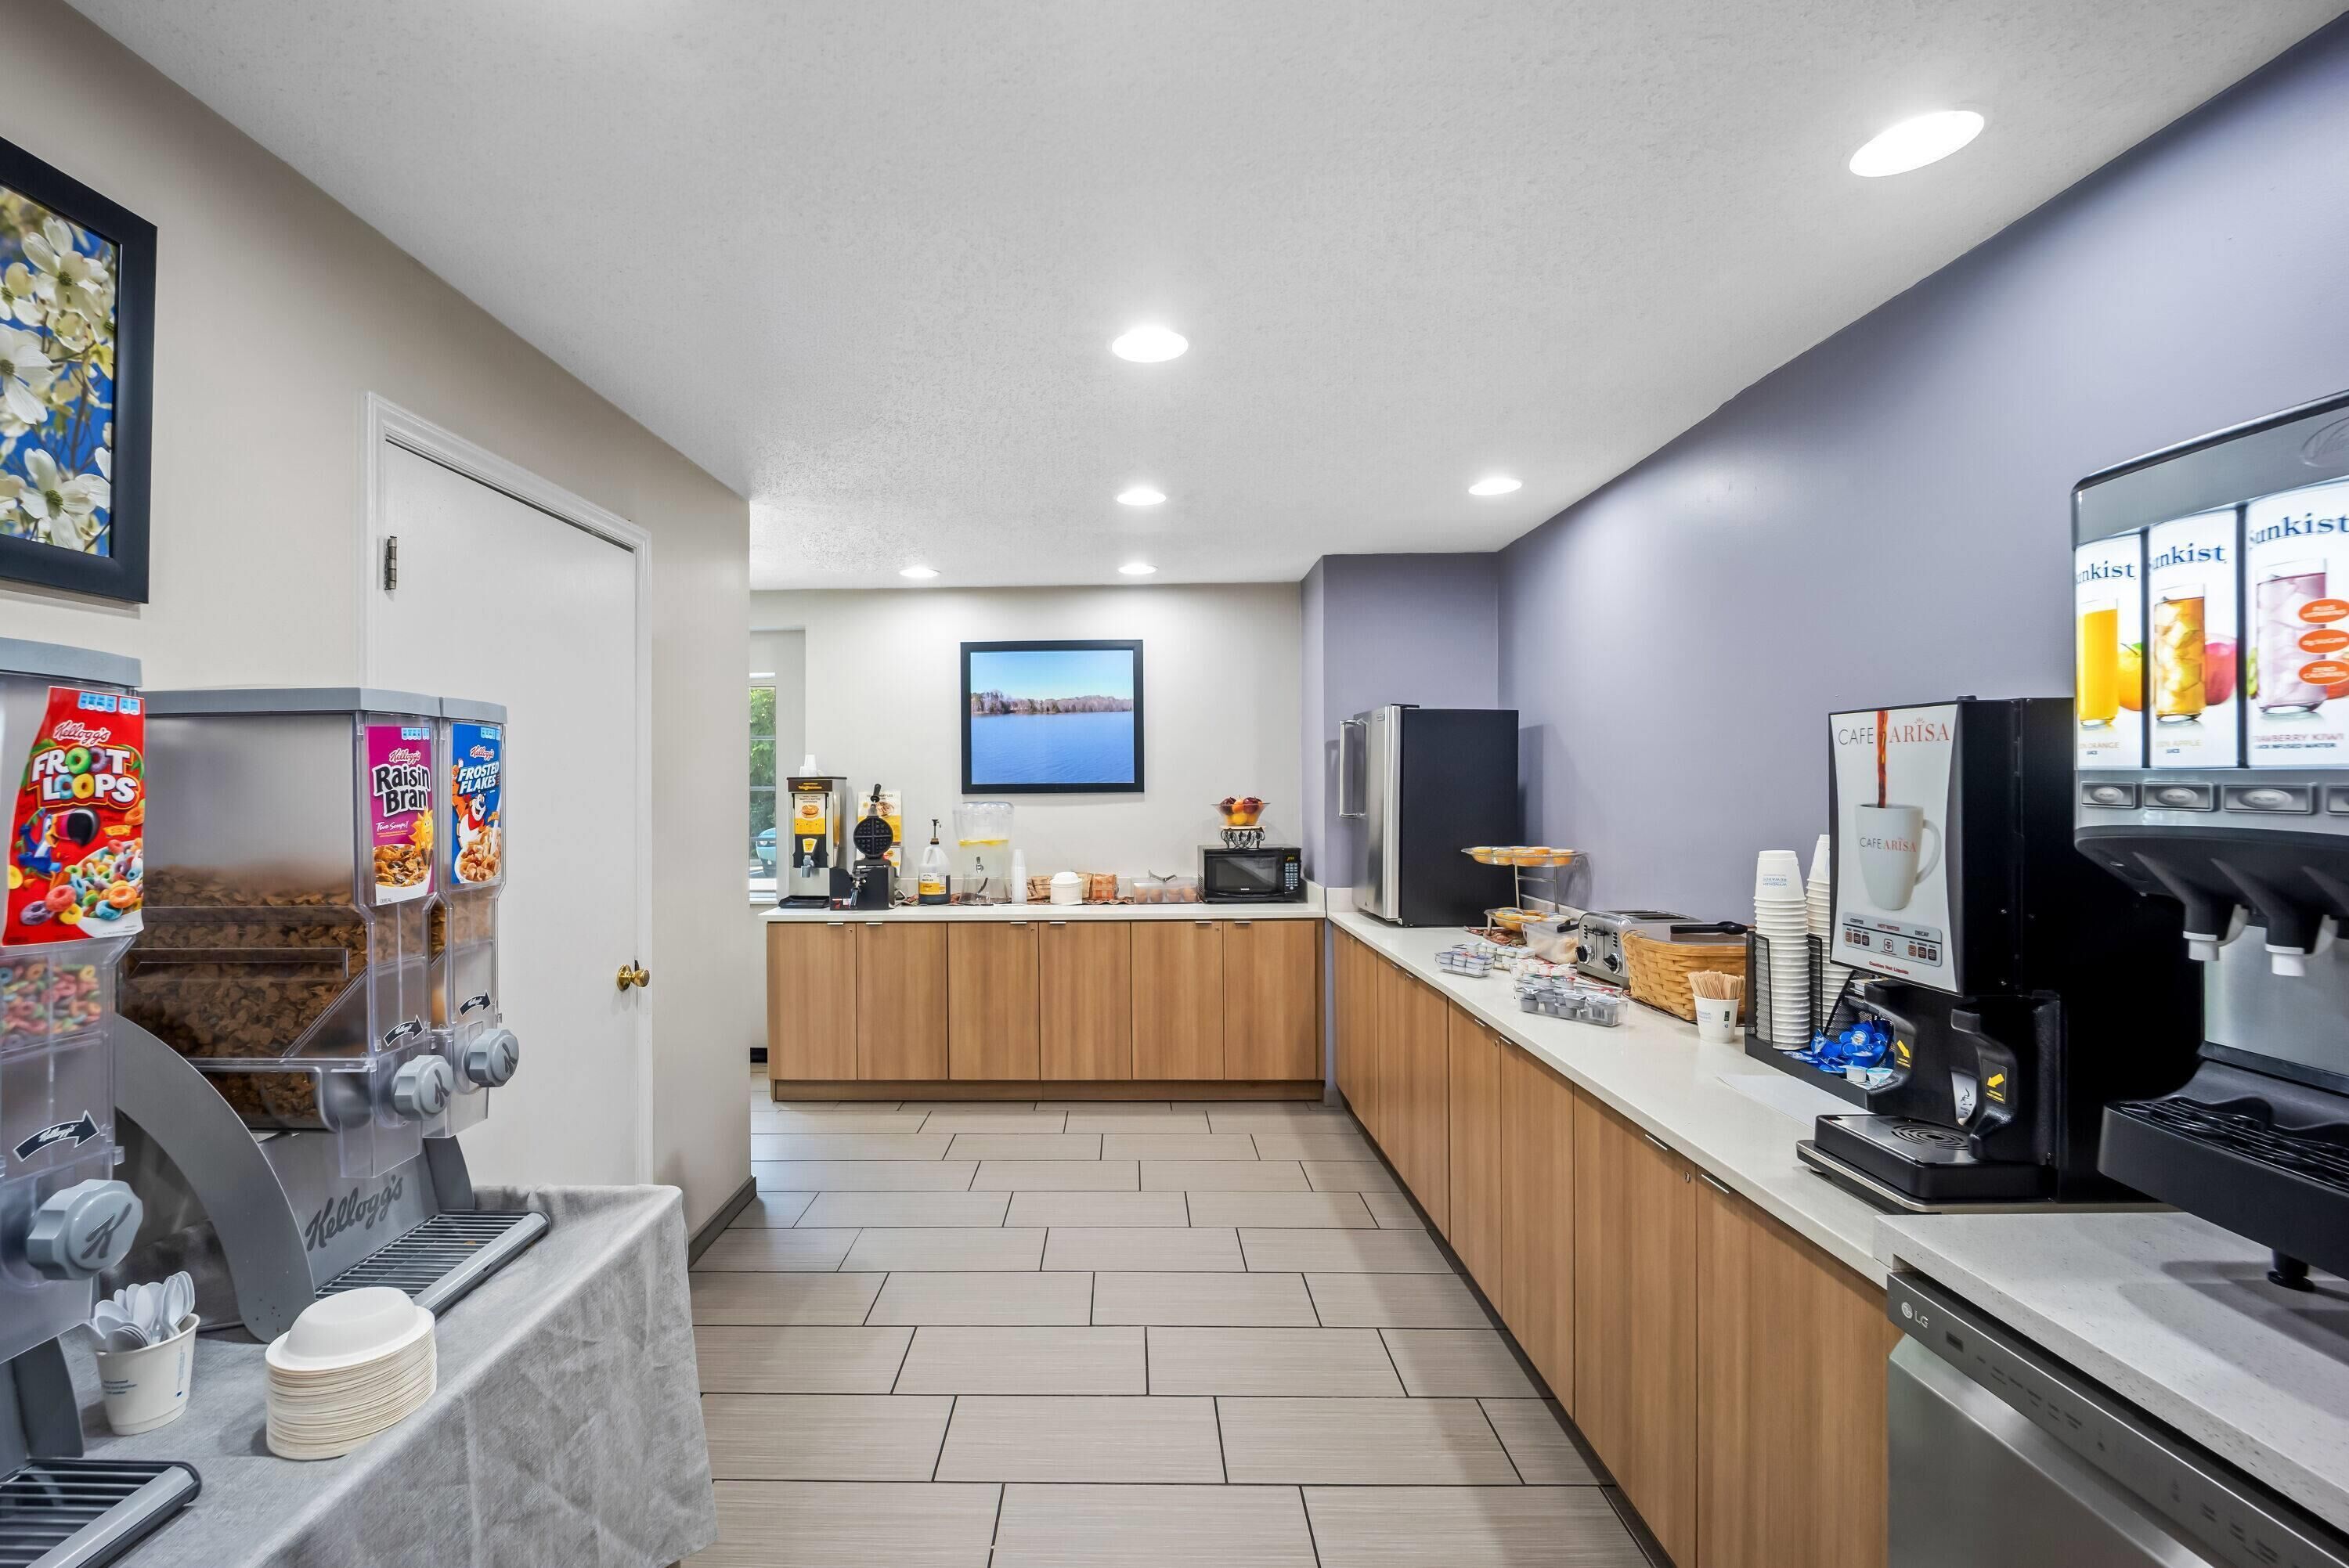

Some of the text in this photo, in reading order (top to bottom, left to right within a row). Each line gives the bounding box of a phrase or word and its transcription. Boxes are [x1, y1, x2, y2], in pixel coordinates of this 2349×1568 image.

[2248, 512, 2349, 549] unkist
[53, 720, 111, 746] Kellogg's
[1838, 722, 1950, 745] CAFE ARISA
[389, 748, 420, 765] Kellogg's
[470, 744, 494, 761] Kellogg's
[32, 747, 130, 782] FROOT
[458, 762, 500, 781] FROSTED
[43, 773, 137, 803] LOOPS
[374, 765, 430, 794] Raisin
[459, 774, 496, 794] FLAKES
[385, 788, 427, 814] Bran
[376, 821, 389, 831] Two
[1860, 837, 1917, 852] CAFE ARISA
[305, 1174, 403, 1252] Kellogg's
[1914, 1310, 1929, 1328] LG
